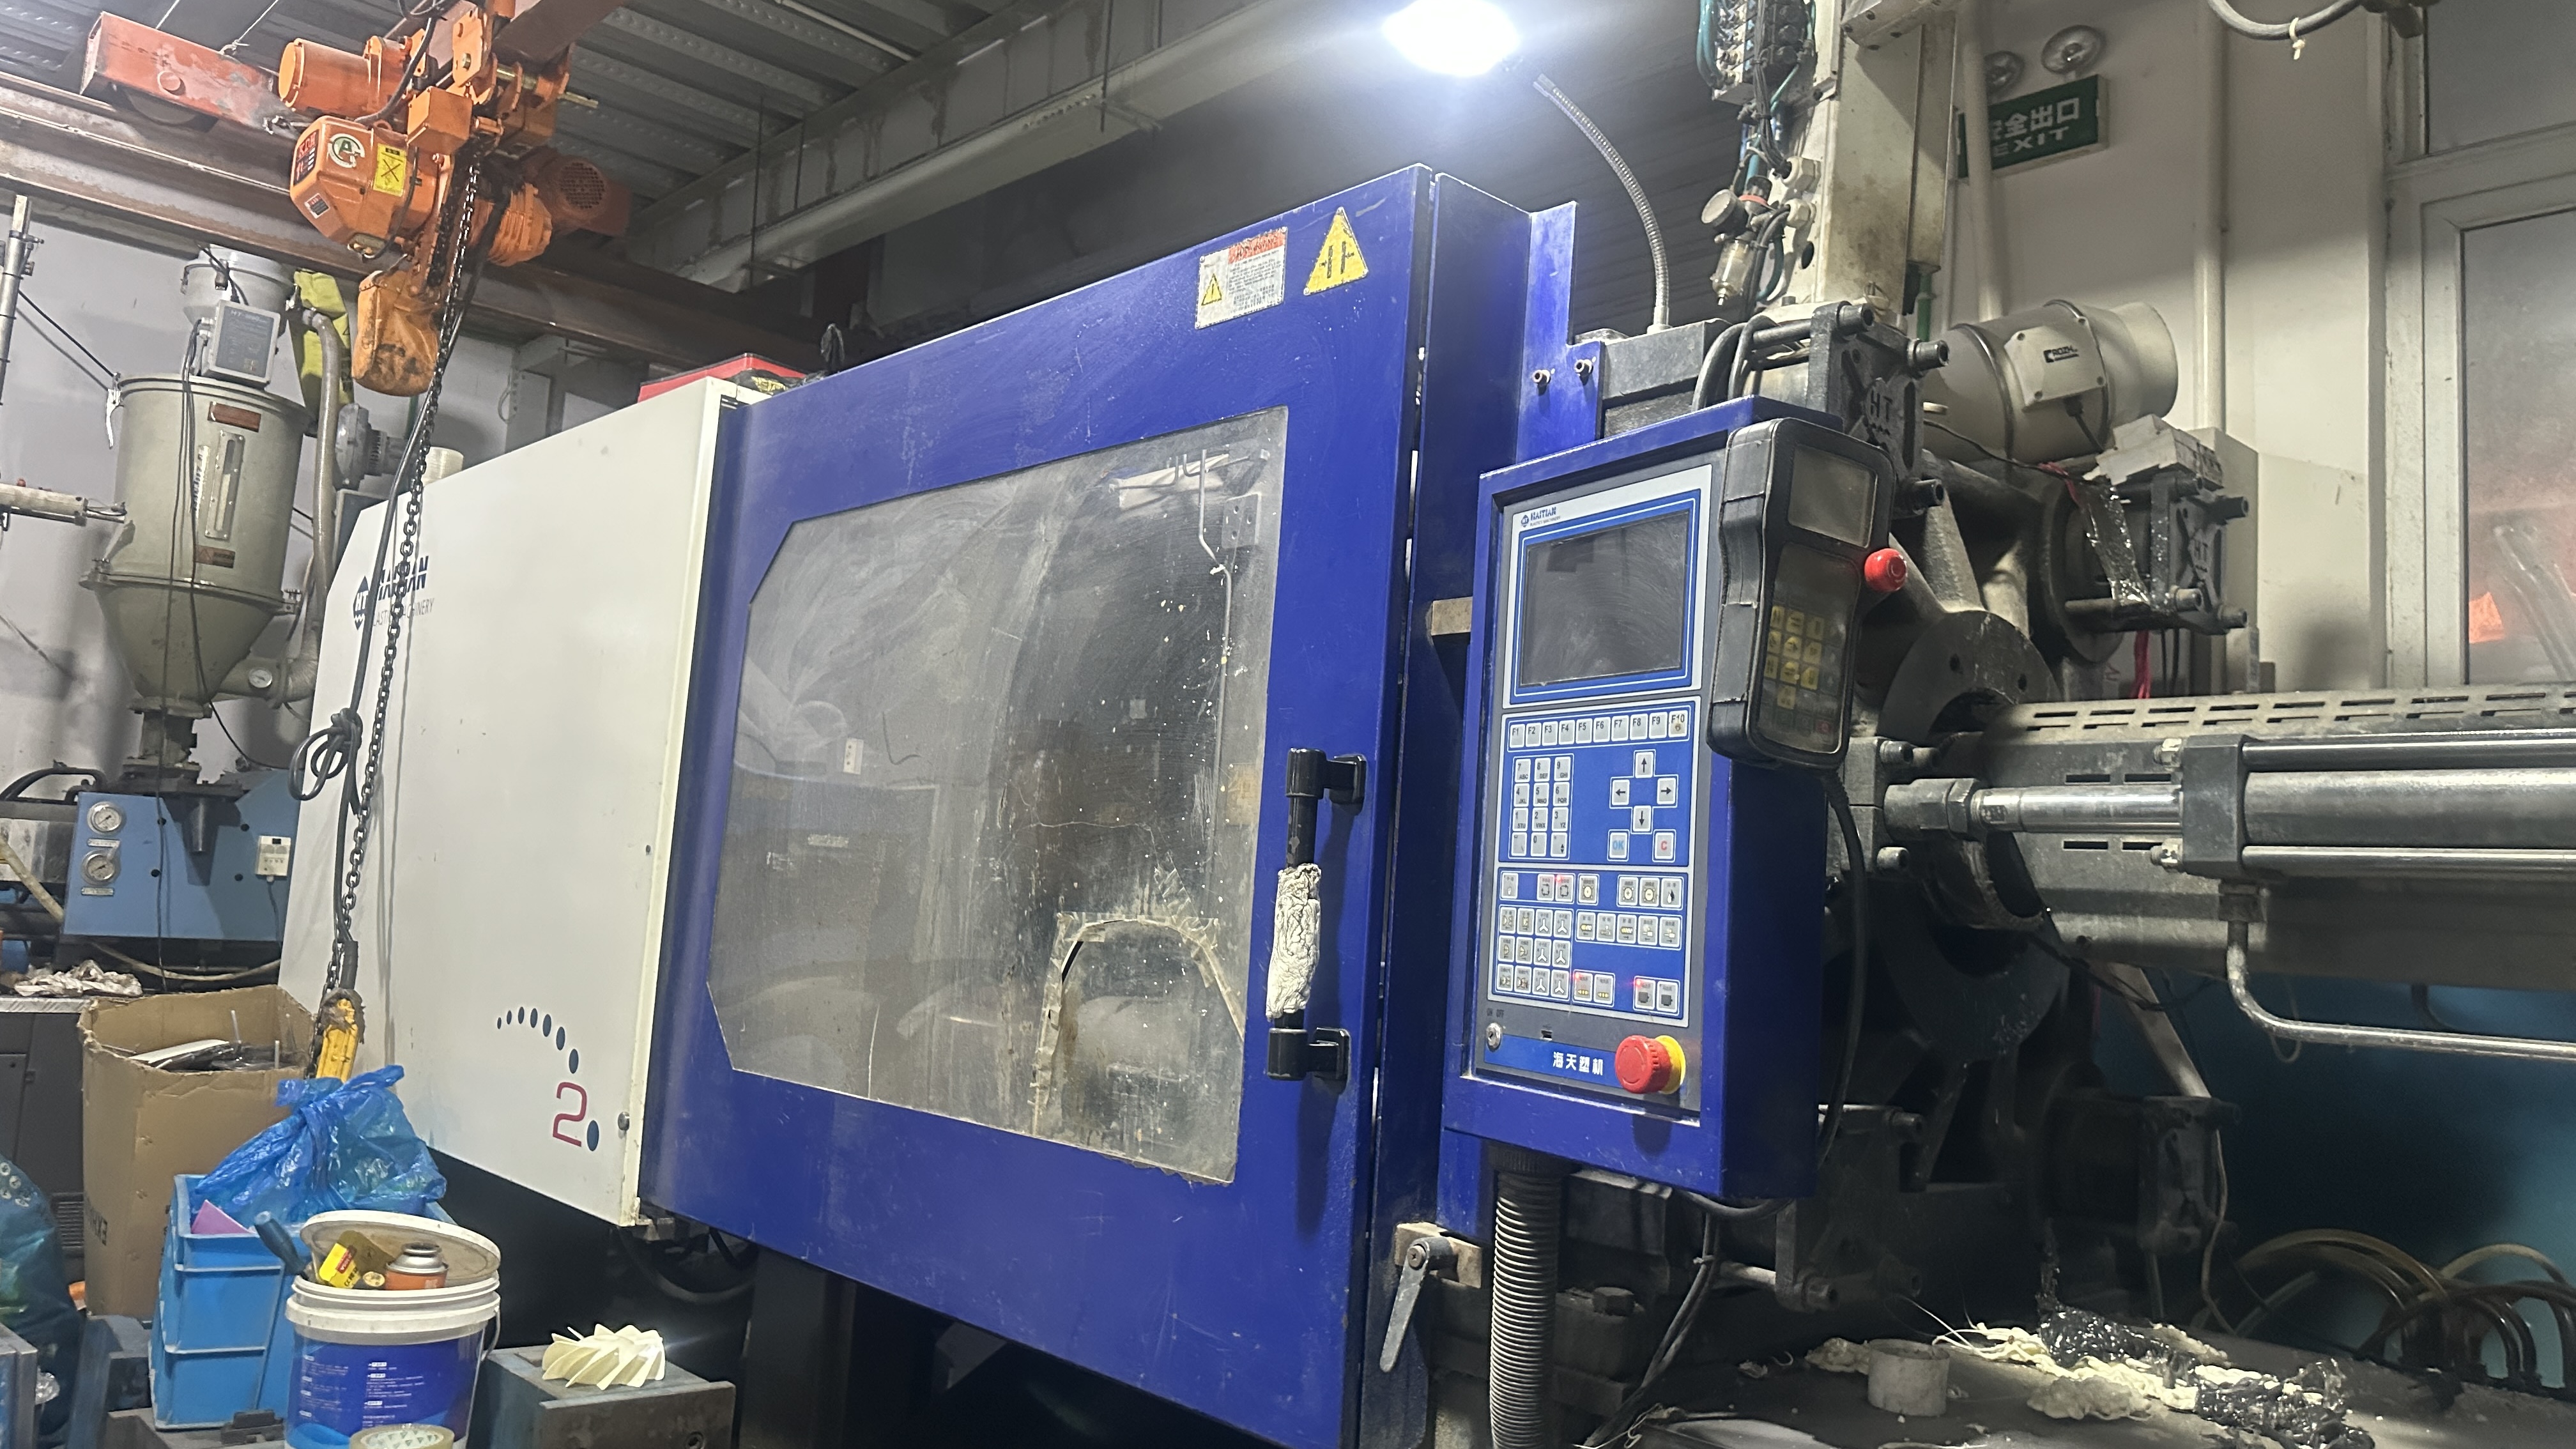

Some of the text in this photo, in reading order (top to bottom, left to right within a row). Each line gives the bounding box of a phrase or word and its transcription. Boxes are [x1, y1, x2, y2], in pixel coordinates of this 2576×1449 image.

[1993, 126, 2069, 157] EXIT
[1531, 507, 1556, 521] HAITIAN
[355, 590, 369, 611] HT
[1633, 718, 1641, 726] F8
[1652, 716, 1660, 725] F9
[1671, 714, 1685, 723] F10
[1614, 719, 1622, 728] F7
[1515, 811, 1519, 820] 1
[1613, 840, 1623, 850] OK
[1661, 841, 1667, 850] C
[1552, 1051, 1604, 1076] 海天塑机
[552, 1082, 588, 1147] 2
